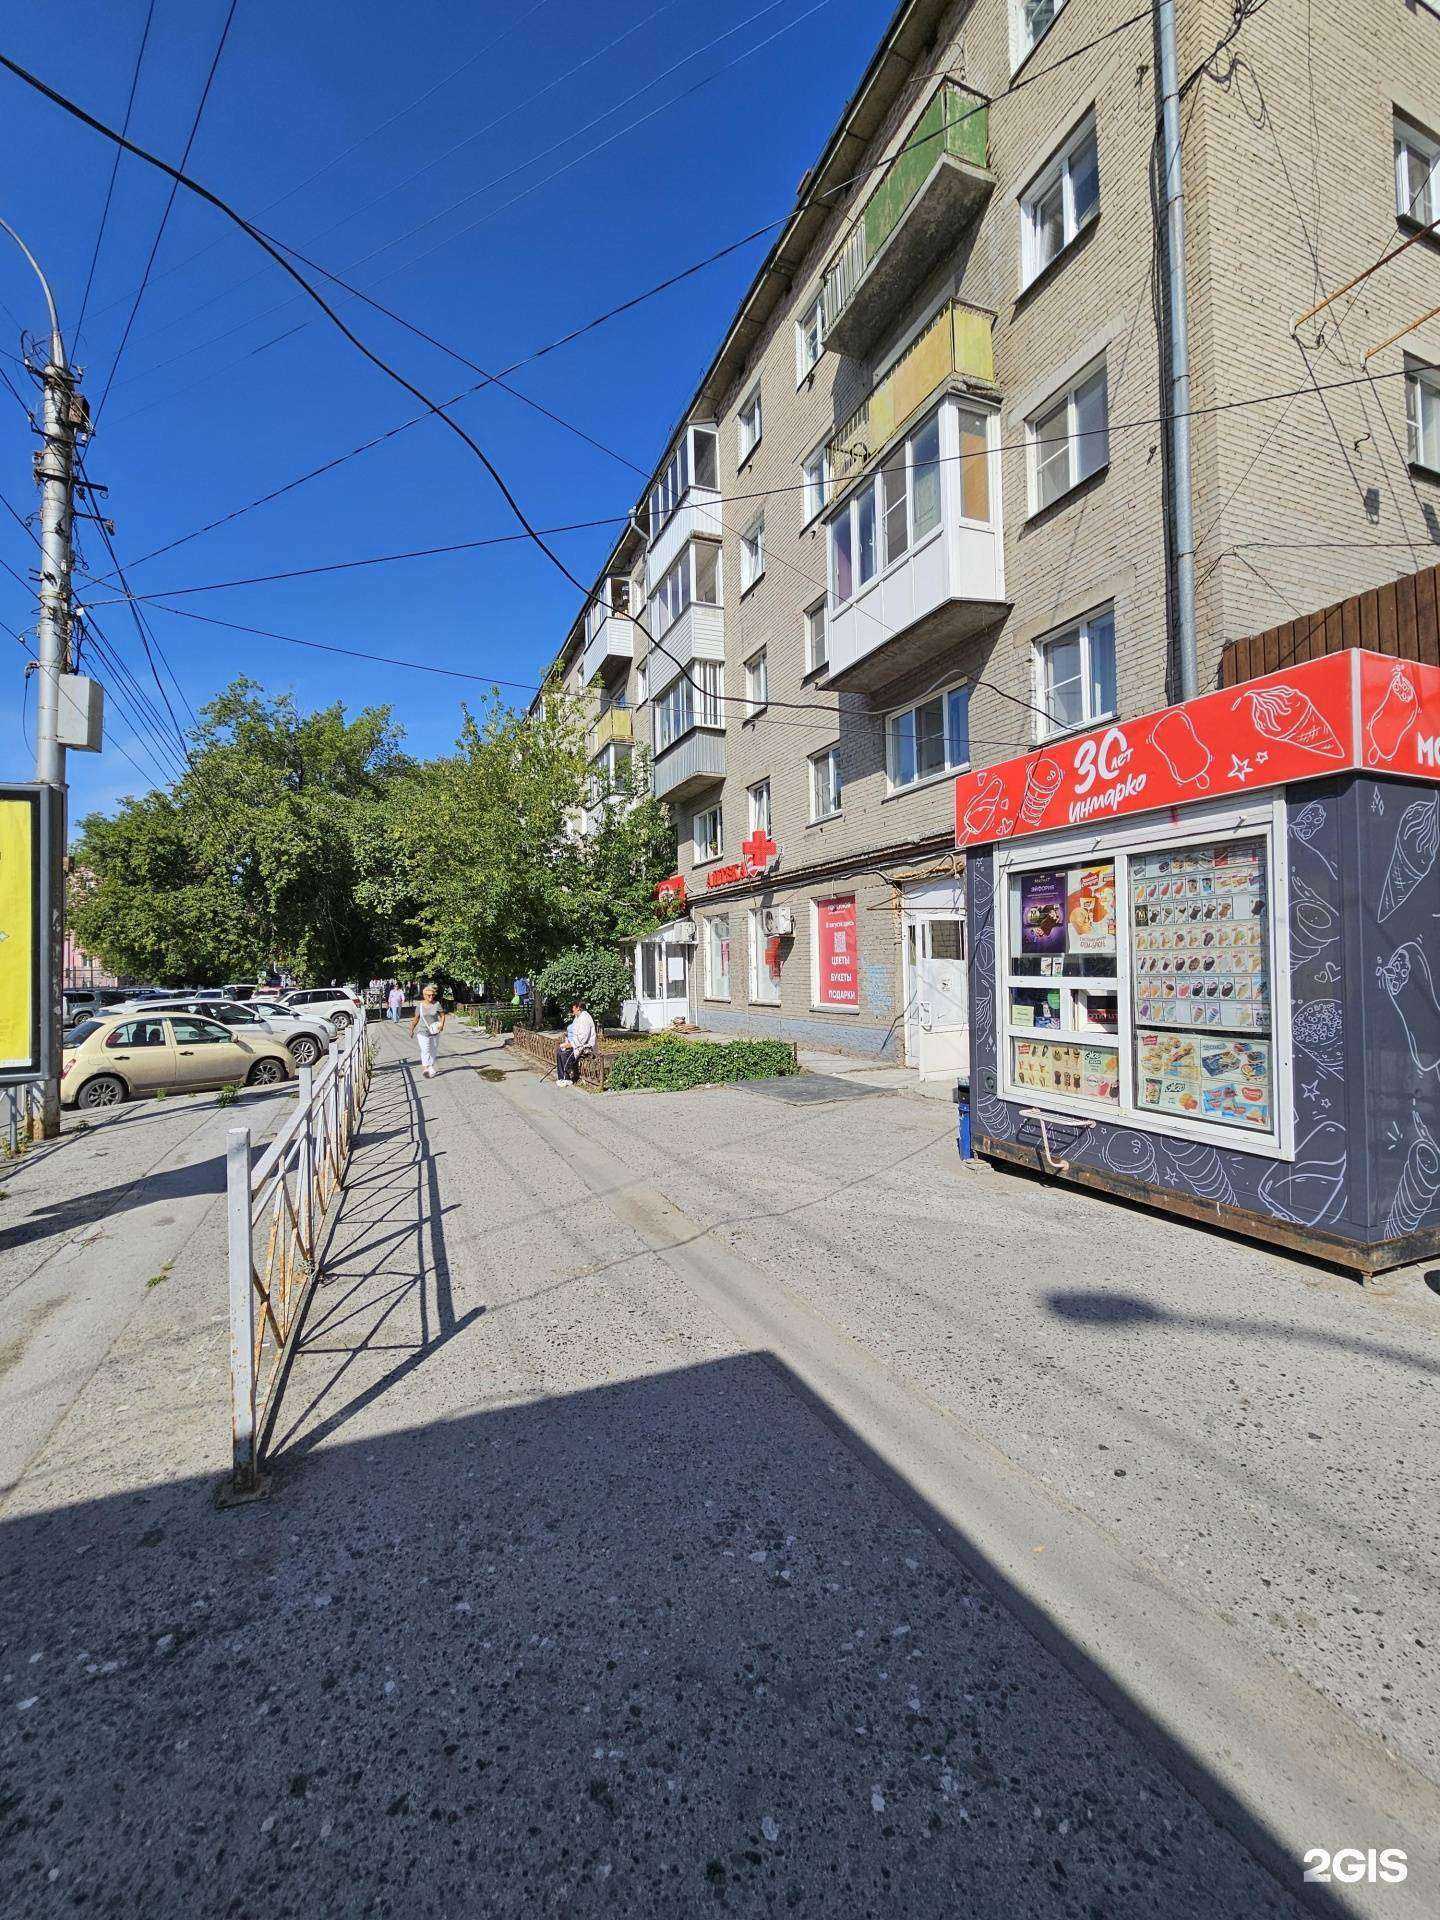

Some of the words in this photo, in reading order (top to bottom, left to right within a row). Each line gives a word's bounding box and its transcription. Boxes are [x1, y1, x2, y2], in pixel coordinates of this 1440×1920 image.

[1074, 727, 1127, 794] 30
[832, 956, 850, 966] ЦВЕТЫ
[830, 973, 852, 982] БУКЕТЫ
[828, 990, 856, 1000] ПОДАРКИ
